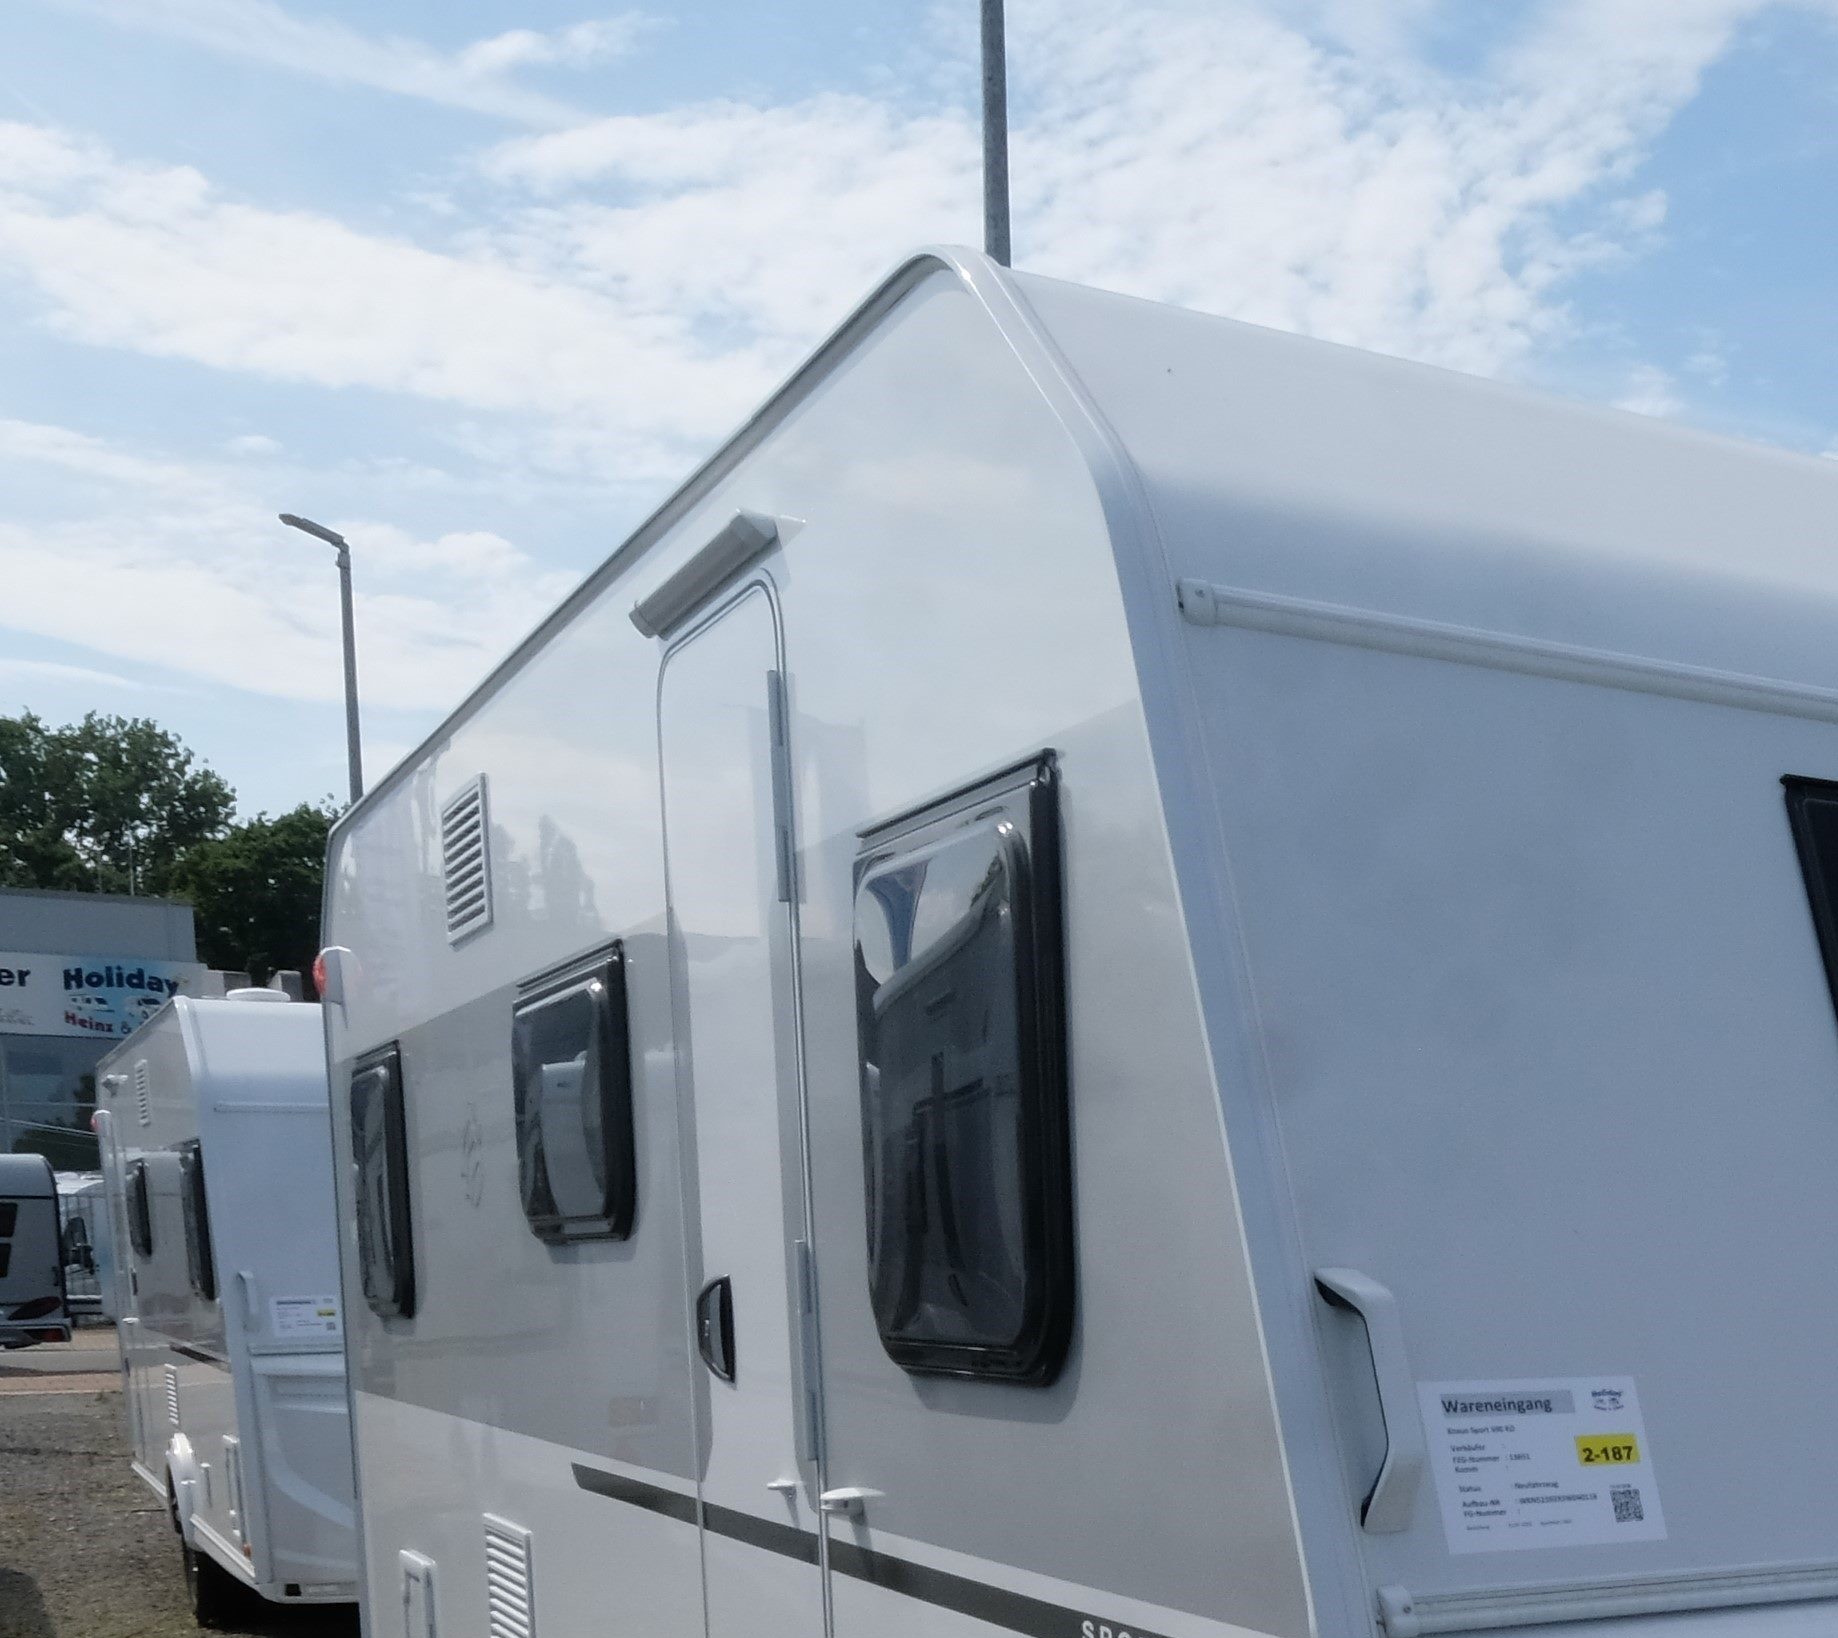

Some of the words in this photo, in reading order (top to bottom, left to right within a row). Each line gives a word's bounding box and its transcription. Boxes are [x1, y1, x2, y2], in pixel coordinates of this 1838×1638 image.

[63, 965, 179, 998] Holiday
[65, 1011, 114, 1033] Heinz
[1441, 1398, 1553, 1413] Wareneingang
[1582, 1446, 1633, 1463] 2-187
